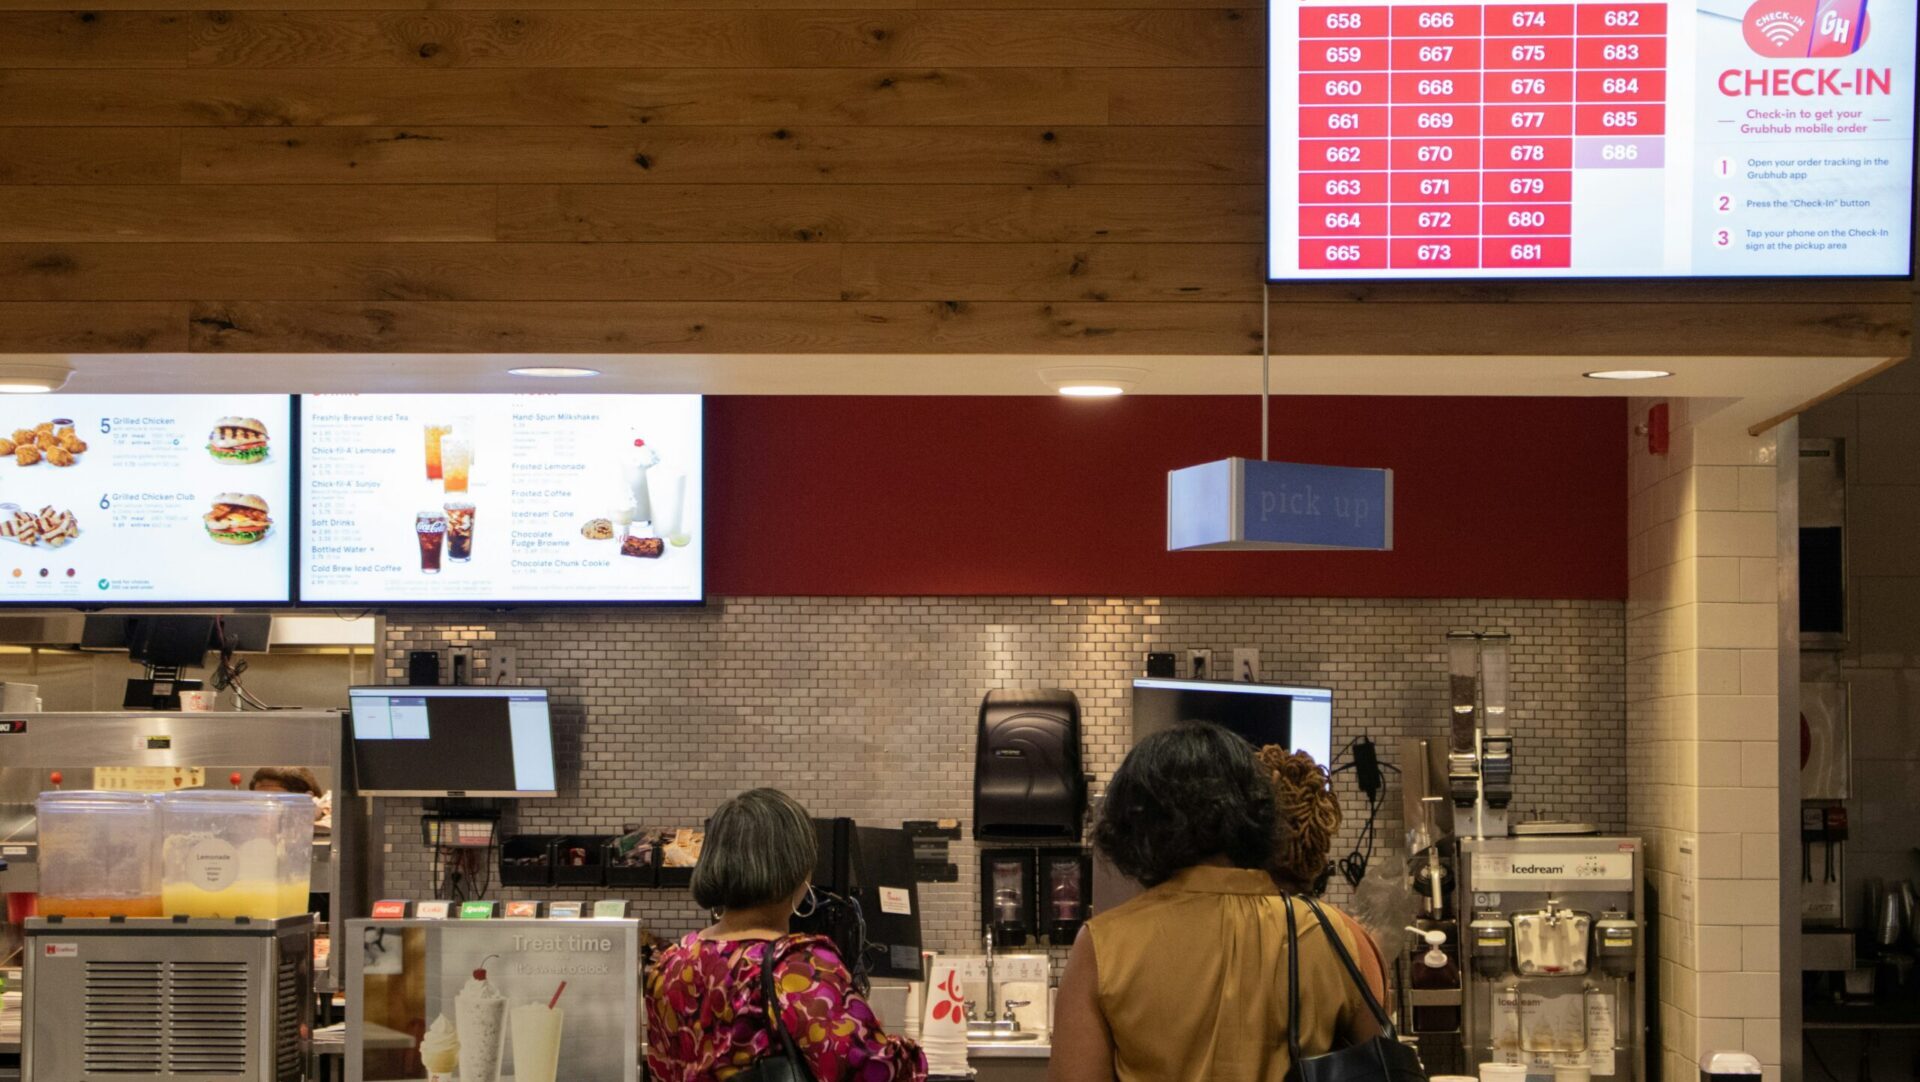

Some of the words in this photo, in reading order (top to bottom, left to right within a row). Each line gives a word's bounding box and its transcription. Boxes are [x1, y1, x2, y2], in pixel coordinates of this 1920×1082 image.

[1327, 14, 1361, 28] 658
[1419, 13, 1453, 27] 666
[1513, 12, 1545, 27] 674
[1605, 11, 1639, 26] 682
[1755, 11, 1805, 27] CHECK-IN
[1820, 10, 1850, 44] GH
[1327, 47, 1361, 62] 659
[1420, 46, 1453, 61] 667
[1512, 46, 1545, 60] 675
[1604, 45, 1638, 60] 683
[1326, 81, 1361, 95] 660
[1419, 80, 1453, 94] 668
[1512, 79, 1545, 94] 676
[1603, 78, 1638, 93] 684
[1718, 68, 1891, 97] CHECK-IN
[1329, 114, 1358, 128] 661
[1418, 113, 1453, 128] 669
[1512, 112, 1544, 127] 677
[1603, 112, 1637, 126] 685
[1746, 109, 1796, 119] Check-in
[1800, 109, 1811, 118] to
[1814, 110, 1832, 121] get
[1836, 110, 1862, 120] your
[1740, 123, 1792, 134] Grubhub
[1795, 123, 1833, 133] mobile
[1836, 123, 1867, 133] order
[1327, 147, 1360, 161] 662
[1418, 146, 1452, 161] 670
[1511, 146, 1543, 160] 678
[1602, 145, 1637, 160] 686
[1721, 160, 1727, 175] 1
[1747, 159, 1772, 169] Open
[1775, 160, 1794, 169] your
[1824, 158, 1861, 168] tracking
[1864, 158, 1871, 166] in
[1874, 158, 1889, 166] the
[1747, 171, 1787, 179] Grubhub
[1790, 173, 1807, 181] app
[1326, 180, 1360, 194] 663
[1421, 179, 1449, 194] 671
[1510, 179, 1543, 193] 679
[1719, 196, 1729, 211] 2
[1747, 200, 1771, 208] Press
[1840, 199, 1870, 207] button
[1326, 213, 1360, 227] 664
[1419, 212, 1451, 227] 672
[1508, 212, 1544, 226] 680
[1718, 231, 1729, 245] 3
[1746, 229, 1762, 239] Tap
[1765, 231, 1784, 239] your
[1787, 229, 1815, 238] phone
[1831, 229, 1846, 237] the
[1848, 229, 1888, 237] Check-In
[1326, 246, 1360, 260] 665
[1418, 245, 1451, 260] 673
[1511, 245, 1540, 259] 681
[1745, 242, 1764, 251] sign
[1778, 242, 1792, 250] the
[1795, 242, 1825, 251] pickup
[100, 418, 110, 434] 5
[113, 417, 139, 425] Grilled
[142, 417, 175, 425] Chicken
[176, 493, 195, 501] Club
[511, 489, 542, 497] Frosted
[544, 489, 572, 497] Coffee
[99, 493, 110, 510] 6
[1260, 484, 1321, 522] pick
[1335, 496, 1368, 527] up
[552, 510, 574, 518] Cone
[511, 530, 553, 538] Chocolate
[312, 545, 341, 553] Bottled
[511, 539, 535, 548] Fudge
[537, 539, 570, 547] Brownie
[311, 564, 330, 572] Cold
[332, 564, 352, 572] Brew
[355, 564, 372, 572] Iced
[374, 564, 402, 572] Coffee
[511, 559, 553, 567] Chocolate
[554, 559, 579, 567] Chunk
[581, 559, 610, 567] Cookie
[1512, 864, 1563, 874] Icedream
[512, 935, 562, 951] Treat
[569, 935, 612, 951] time
[1498, 998, 1541, 1006] Icedeam
